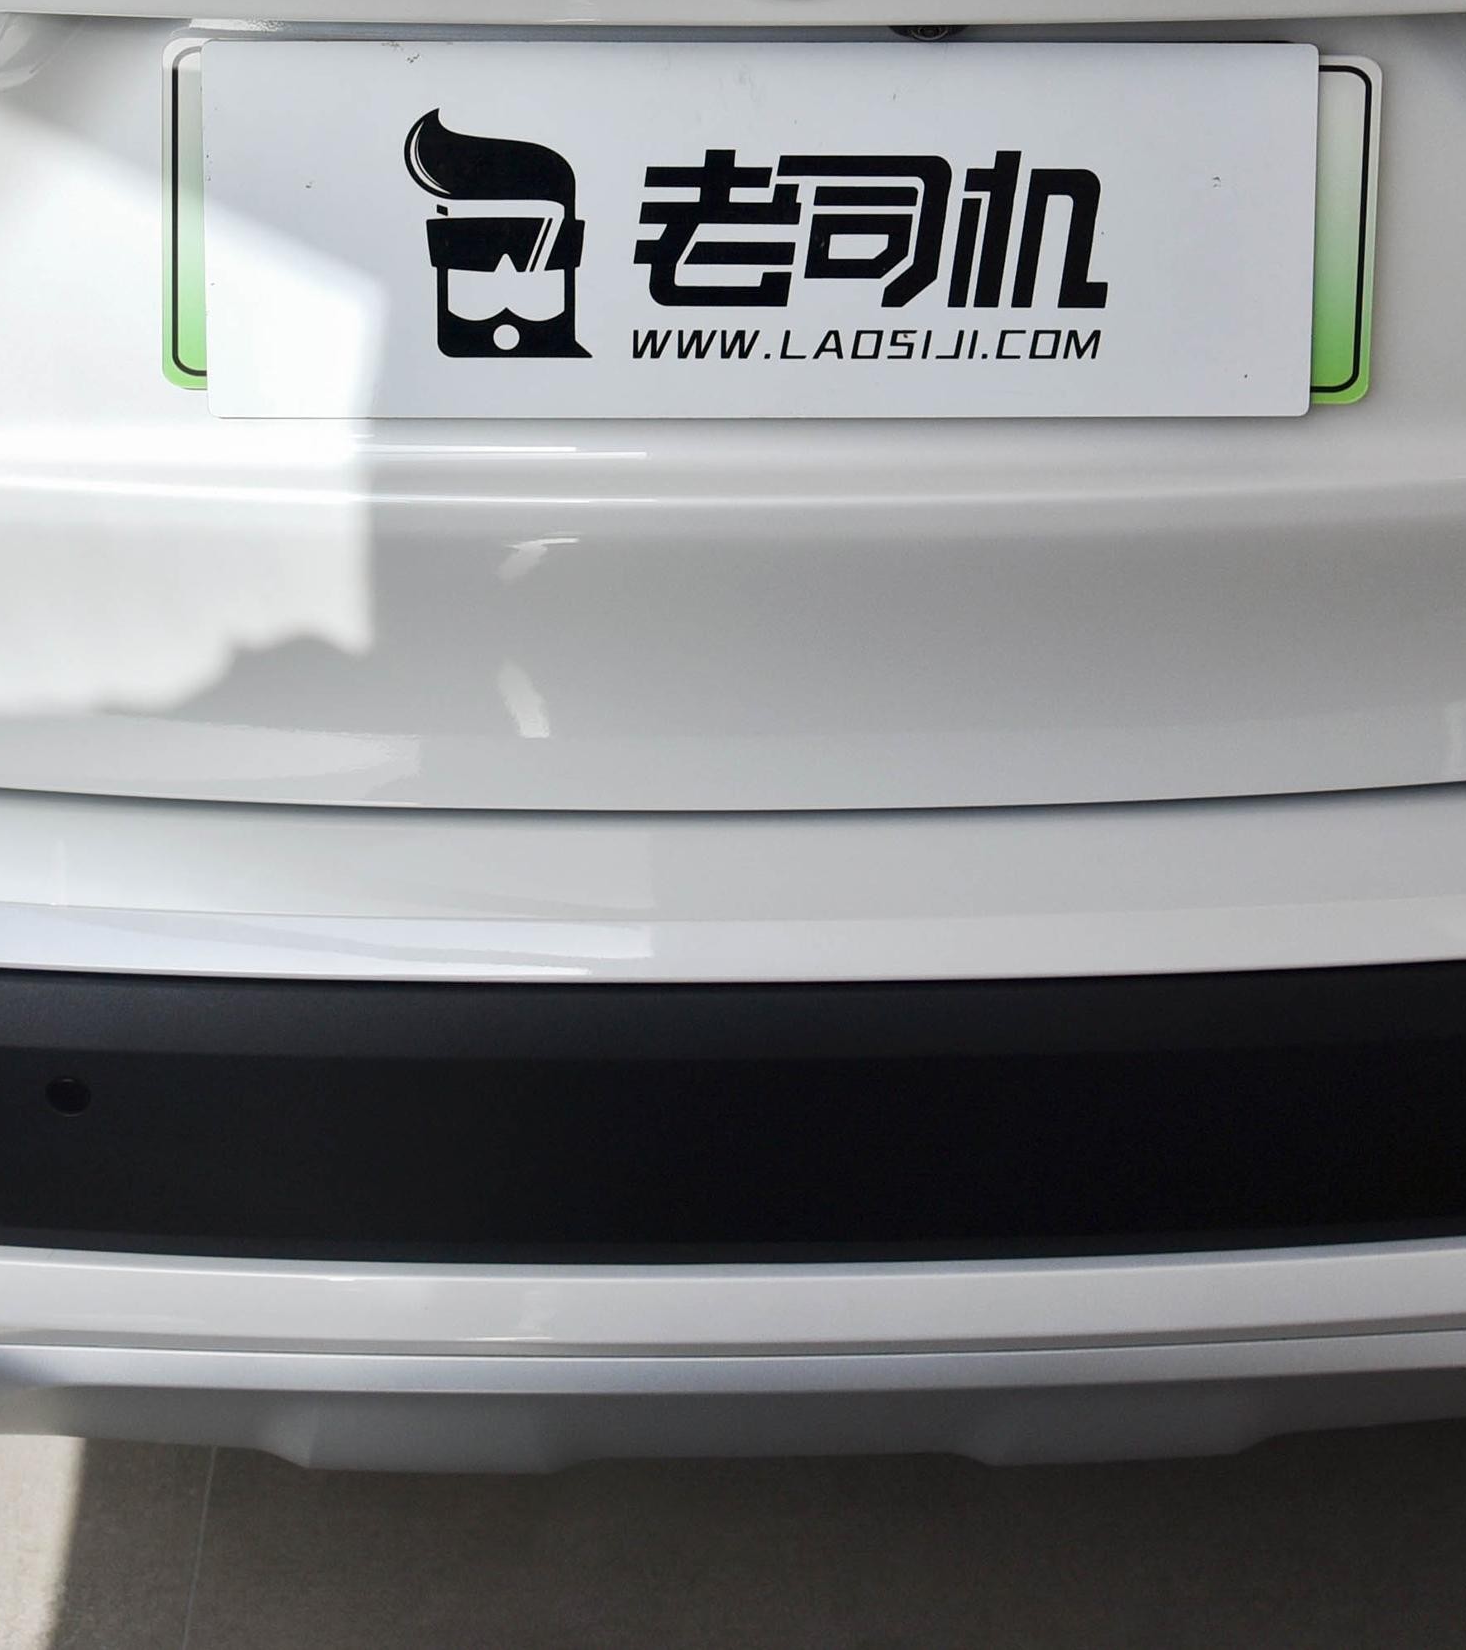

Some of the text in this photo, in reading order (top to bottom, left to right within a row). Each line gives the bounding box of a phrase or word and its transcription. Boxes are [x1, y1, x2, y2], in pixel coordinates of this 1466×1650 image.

[632, 150, 1108, 309] 老司机
[631, 328, 1102, 360] WWW.LAOSIJI.COM
